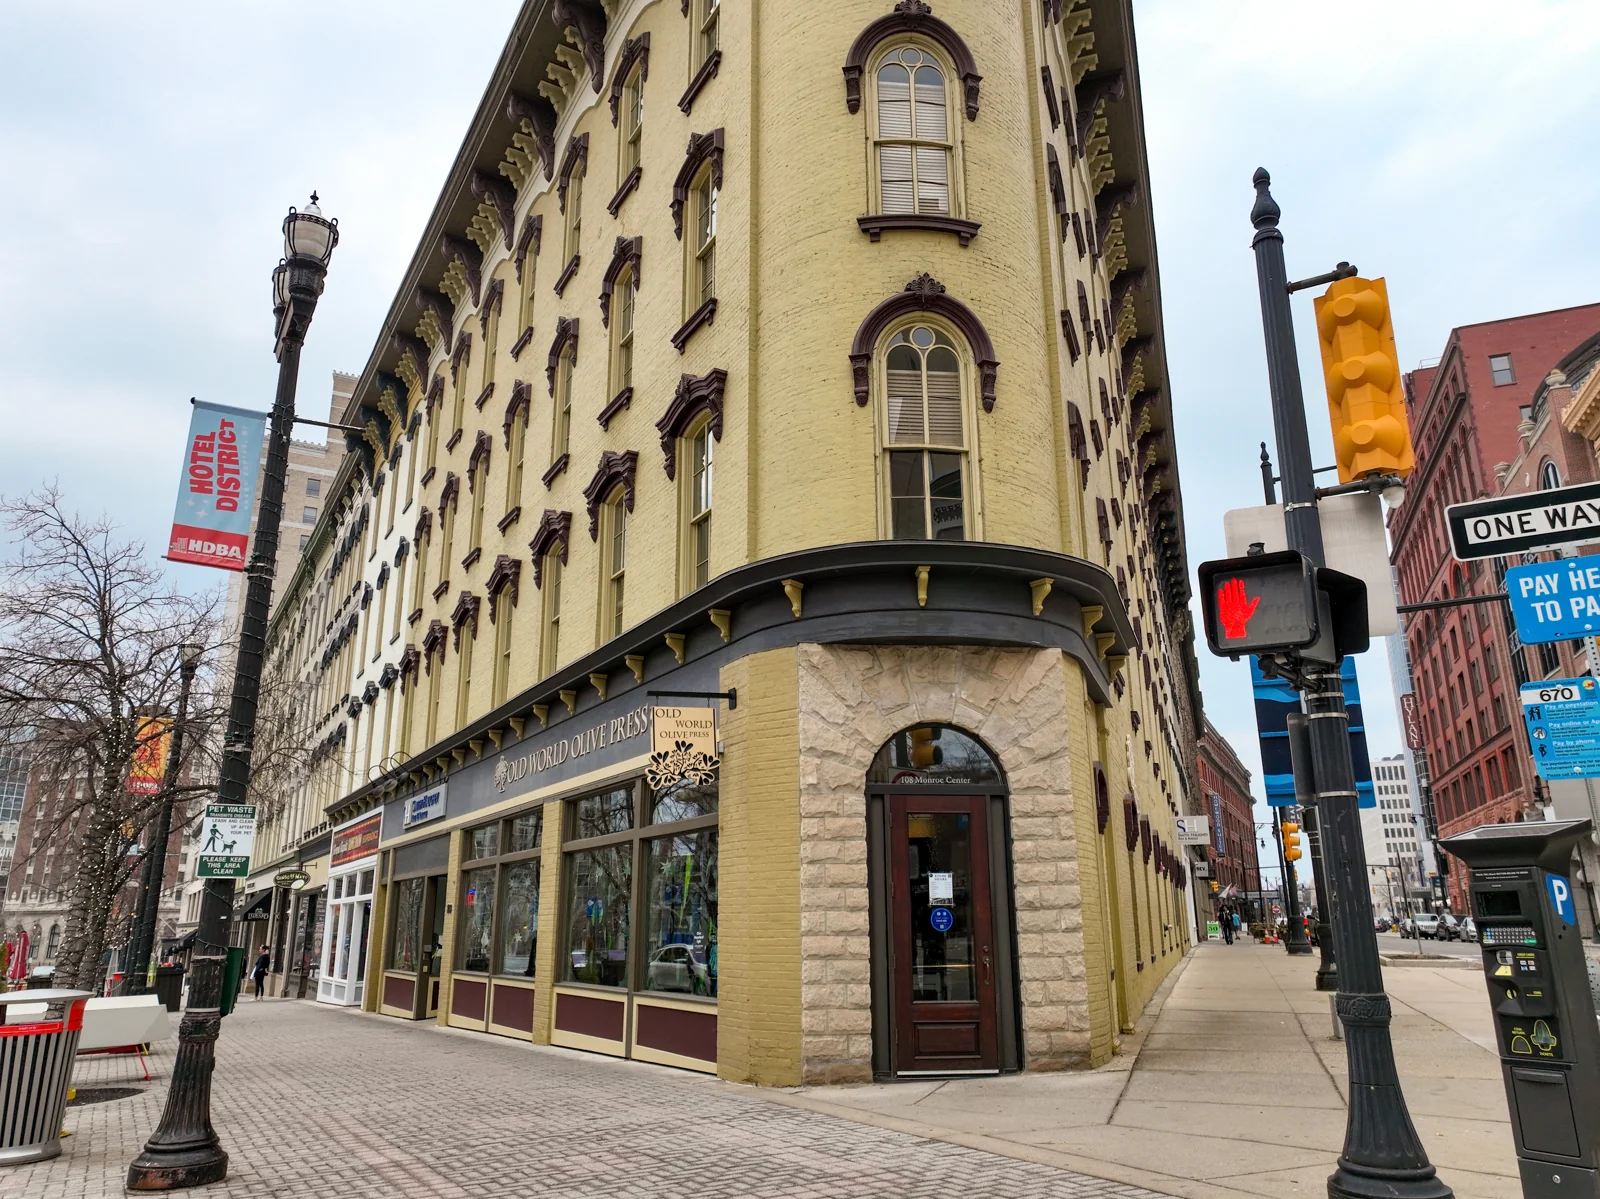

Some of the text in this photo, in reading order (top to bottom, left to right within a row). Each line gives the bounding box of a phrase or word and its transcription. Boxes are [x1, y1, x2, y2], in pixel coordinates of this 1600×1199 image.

[188, 432, 216, 494] HOTEL
[216, 419, 241, 512] DISTRICT
[1473, 503, 1600, 540] ONE WAY
[188, 538, 242, 559] HDBA
[1519, 568, 1600, 598] PAY HE
[1531, 595, 1600, 623] TO PA
[1540, 688, 1573, 702] 670
[655, 708, 681, 718] OLD
[676, 720, 712, 729] WORLD
[1403, 698, 1418, 747] HYLANT
[507, 703, 649, 783] OLD WORLD OLIVE PRESS
[1177, 819, 1197, 832] SH
[1552, 880, 1568, 915] P
